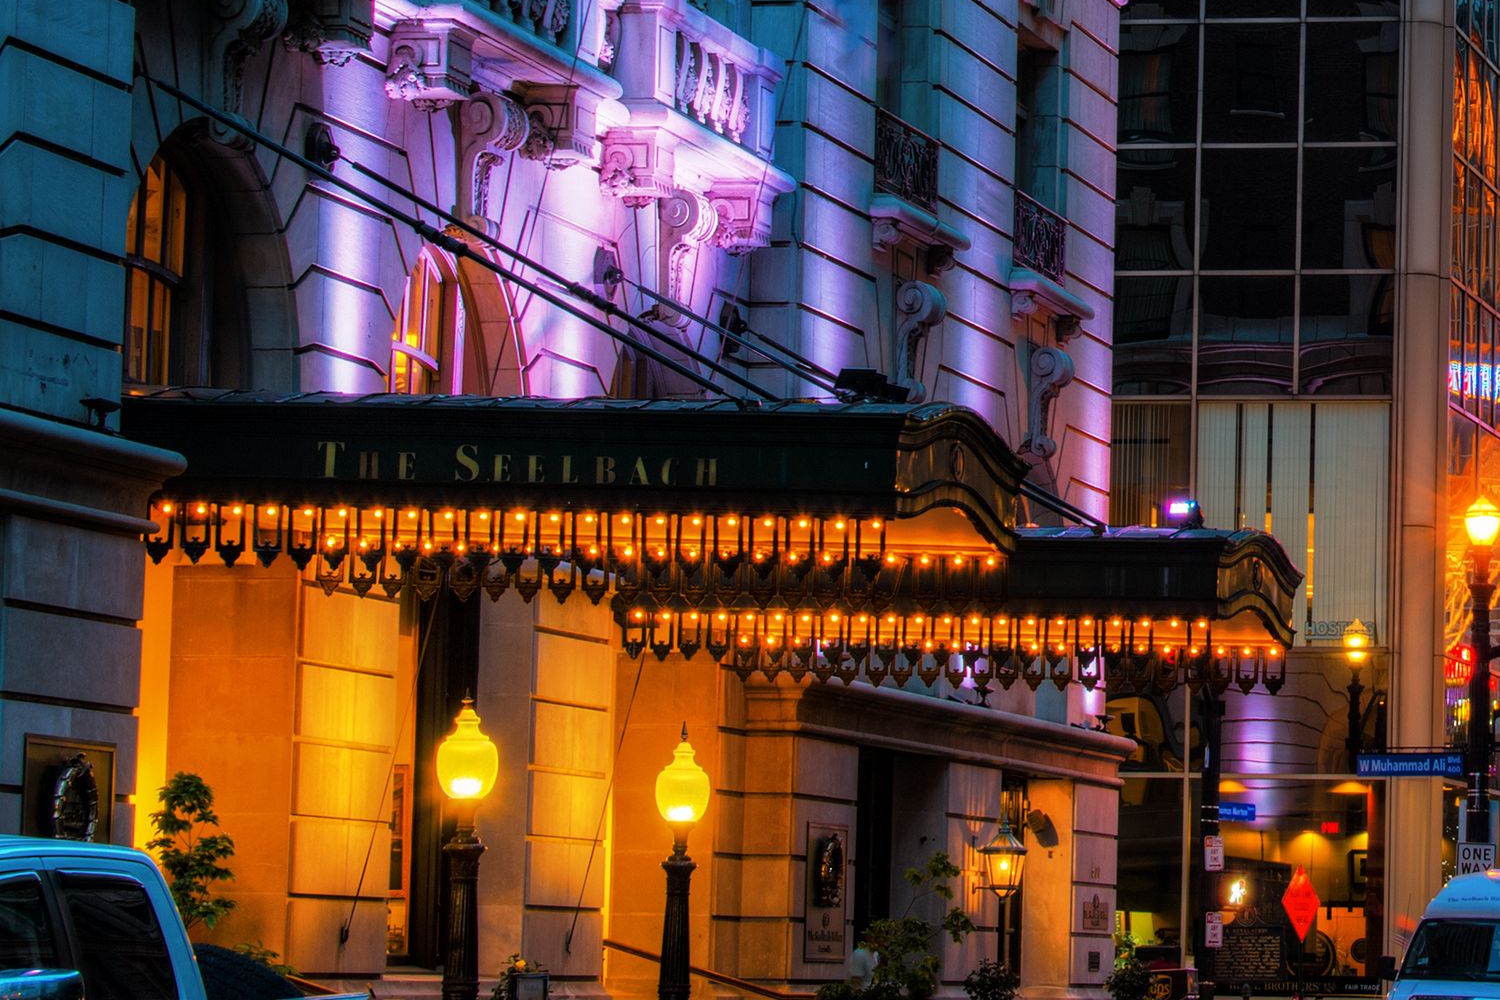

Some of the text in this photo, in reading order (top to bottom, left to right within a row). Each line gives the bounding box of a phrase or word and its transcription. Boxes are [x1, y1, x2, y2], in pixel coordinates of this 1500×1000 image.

[1304, 621, 1374, 636] HOSTG
[1360, 759, 1370, 772] W
[1371, 758, 1431, 772] Muhammad
[1432, 758, 1446, 772] Ali
[1462, 848, 1492, 861] ONE
[1461, 862, 1491, 874] WAY
